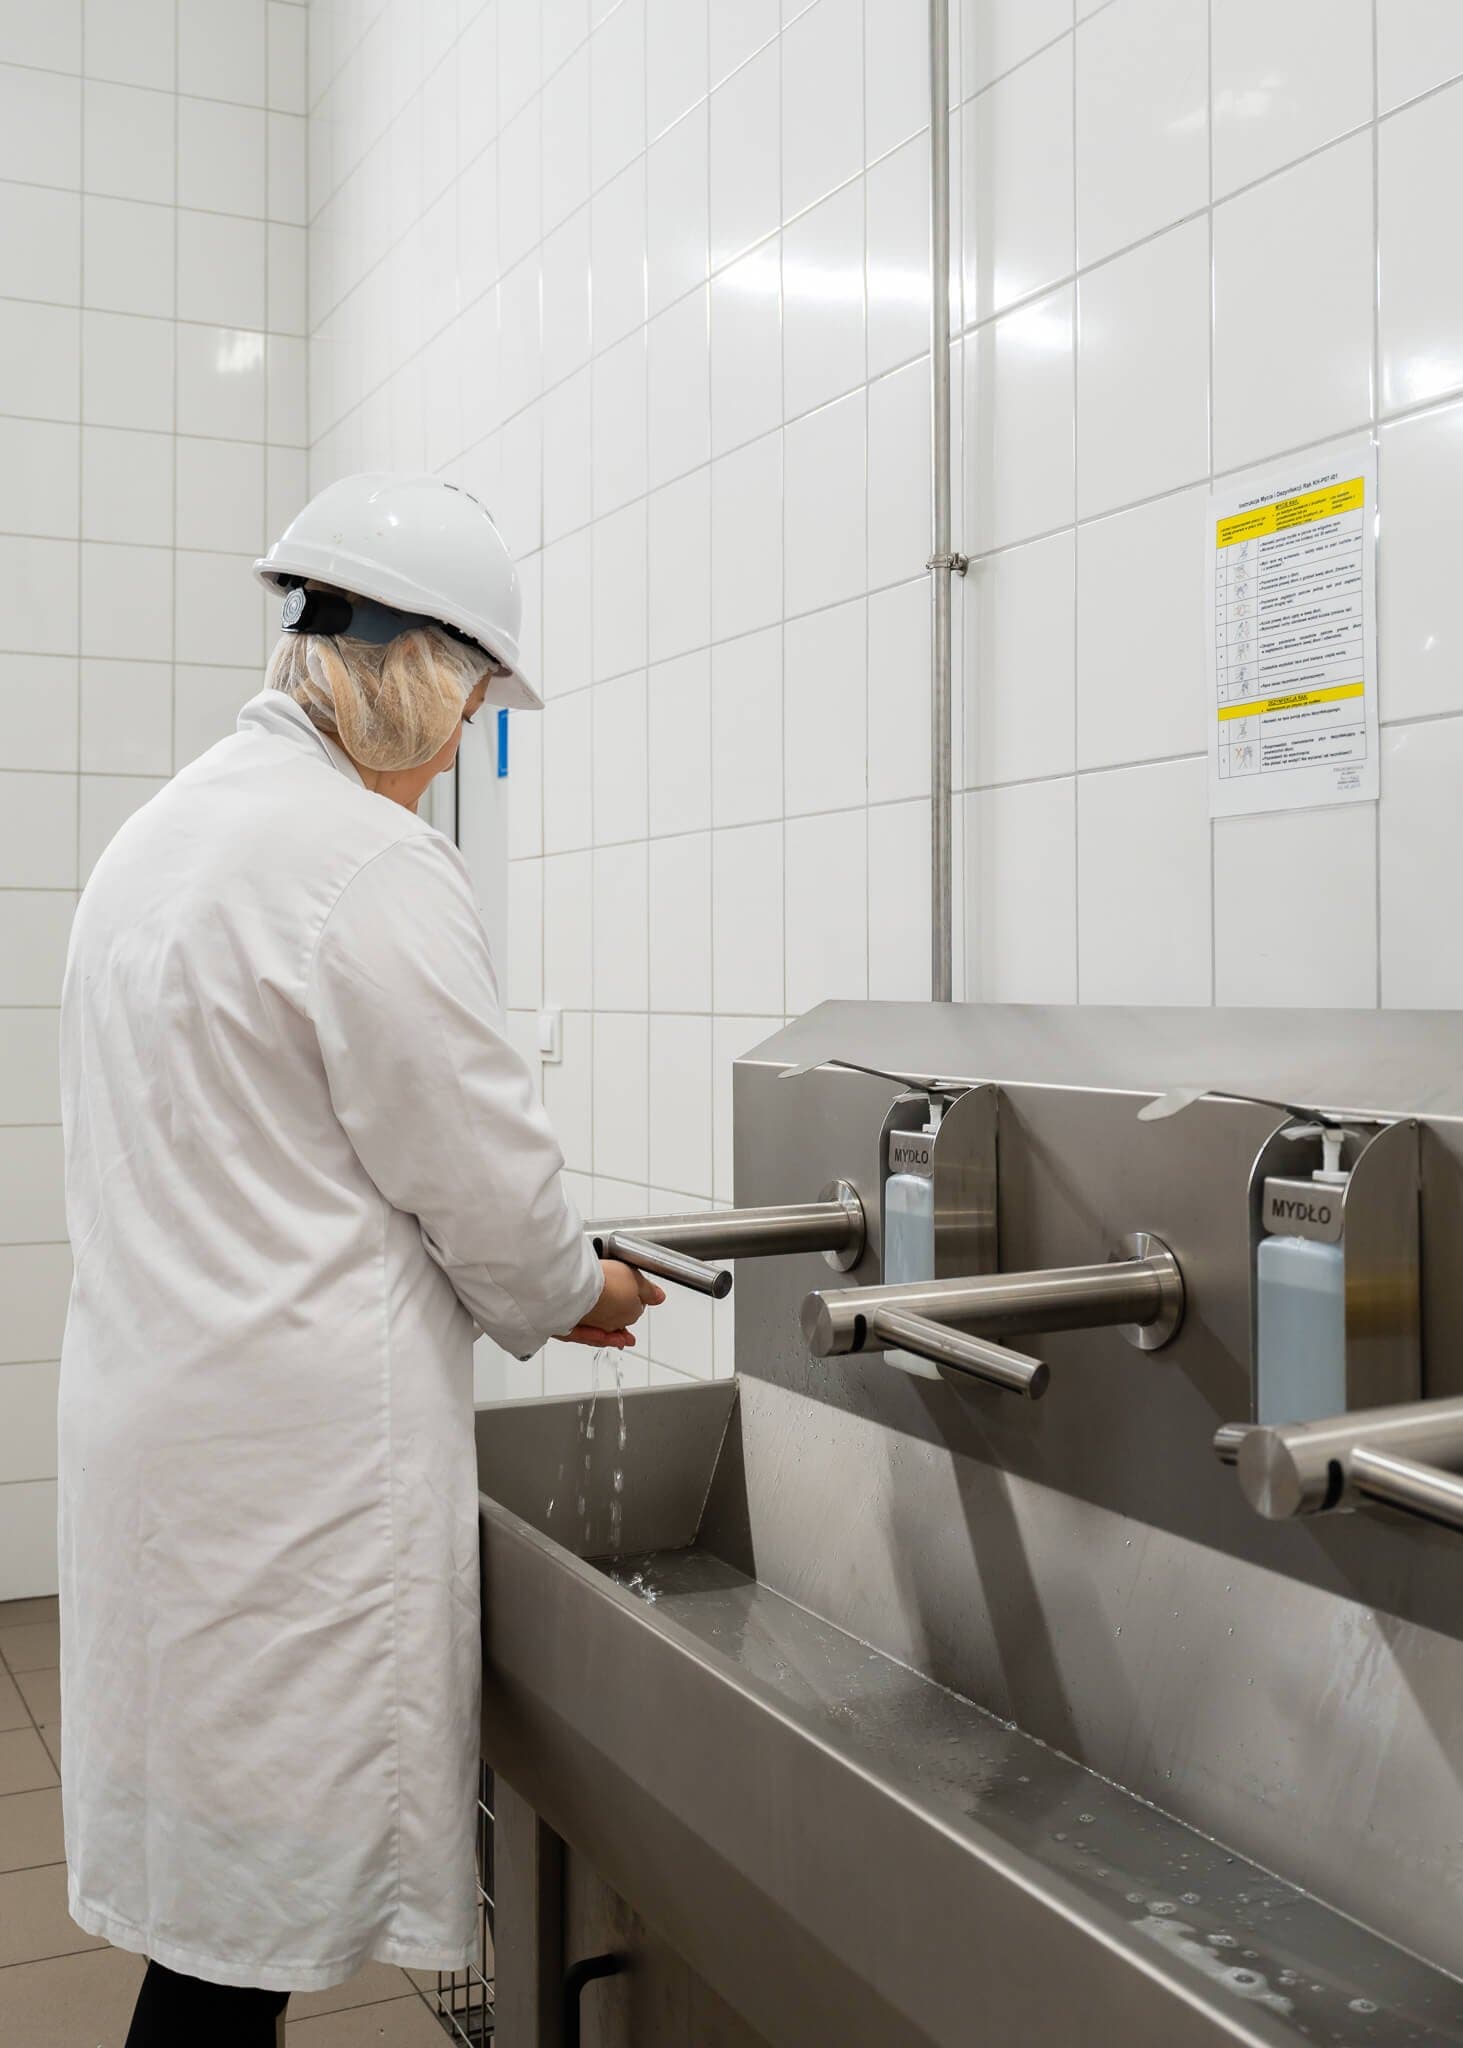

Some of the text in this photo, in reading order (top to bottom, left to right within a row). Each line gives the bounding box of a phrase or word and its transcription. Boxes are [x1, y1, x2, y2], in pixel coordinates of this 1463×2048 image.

[1260, 494, 1274, 503] Mycia
[894, 1147, 929, 1164] MYDŁO
[1271, 1198, 1332, 1225] MYDŁO
